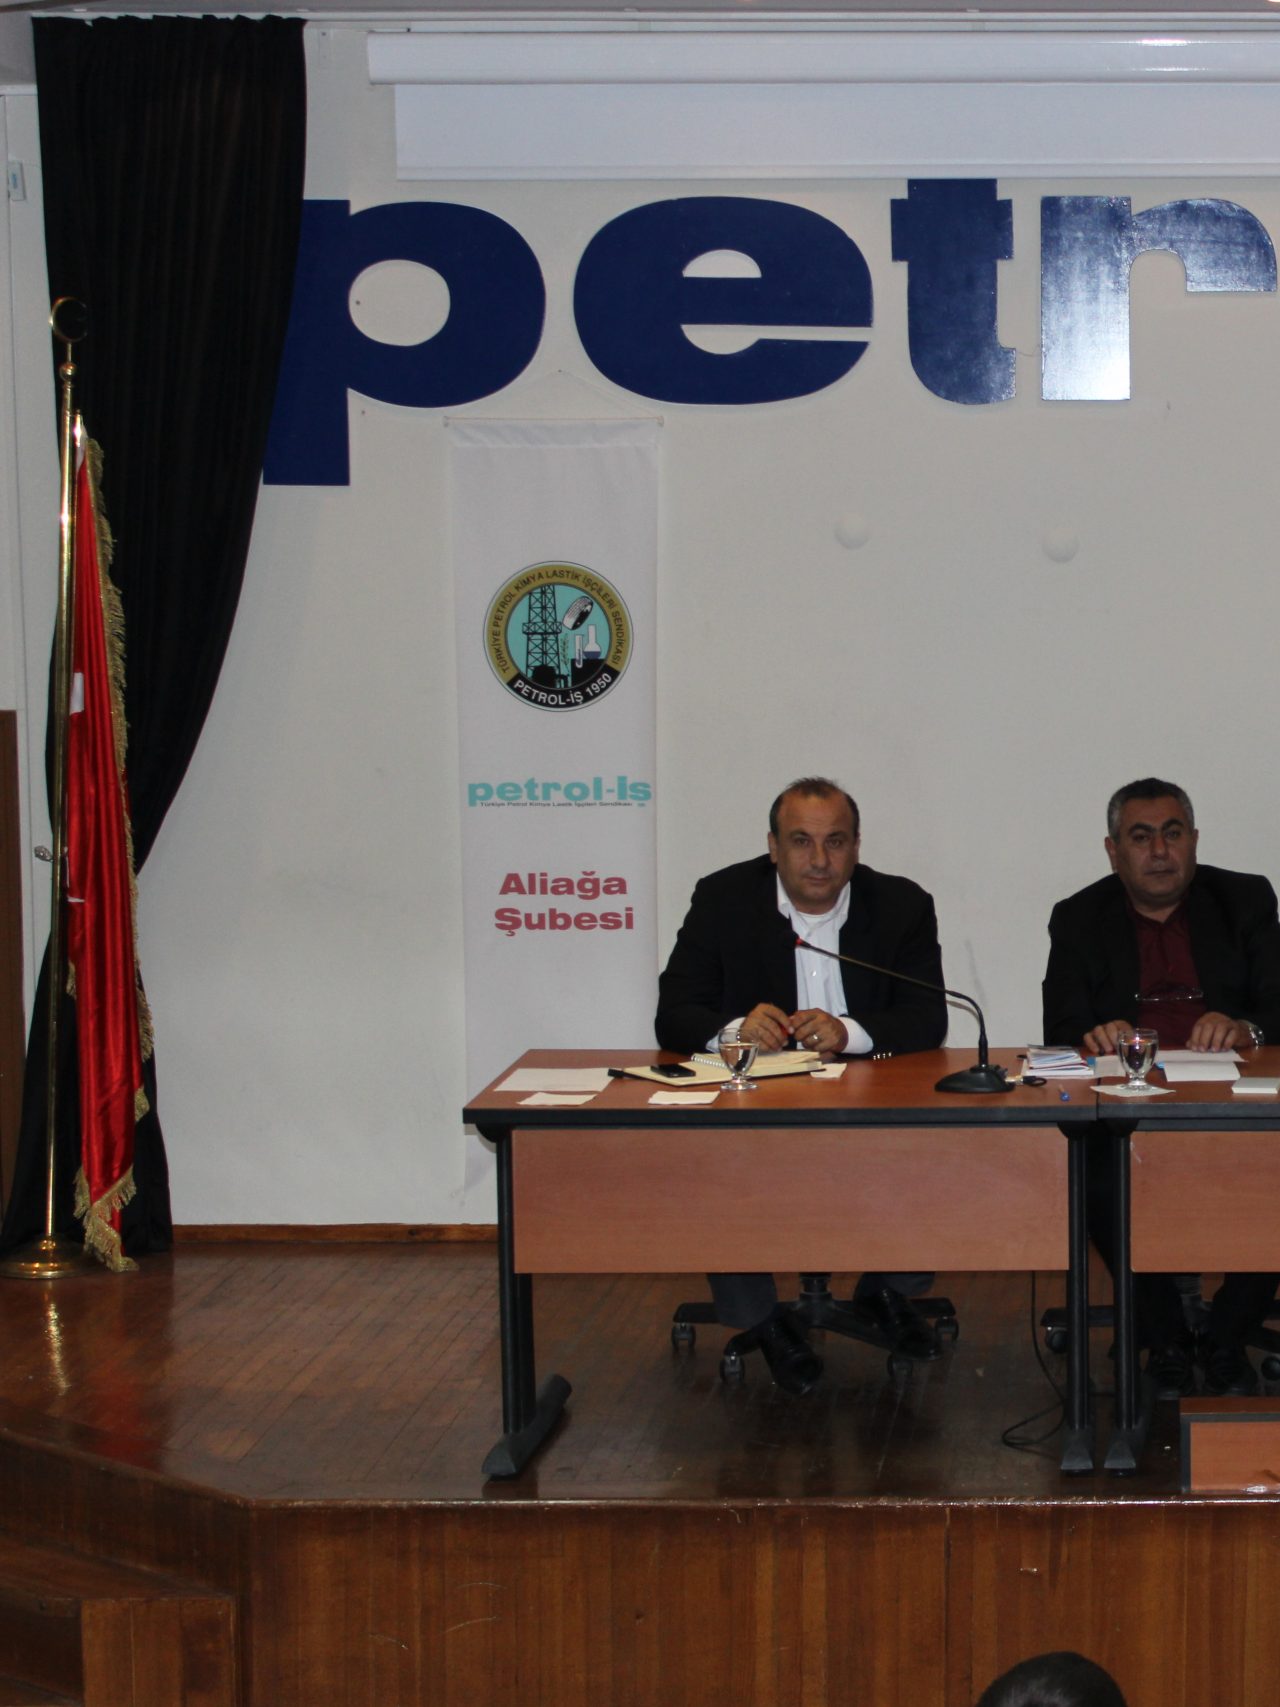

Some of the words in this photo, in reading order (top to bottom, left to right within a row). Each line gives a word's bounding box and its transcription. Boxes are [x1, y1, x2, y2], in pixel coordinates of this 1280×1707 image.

[493, 591, 516, 627] PETROL
[514, 570, 545, 591] KİMYA
[545, 569, 581, 581] LASTİK
[513, 679, 584, 706] PETROL-İŞ
[585, 672, 612, 697] 1950
[498, 870, 628, 901] Aliağa
[494, 906, 634, 937] Şubesi
